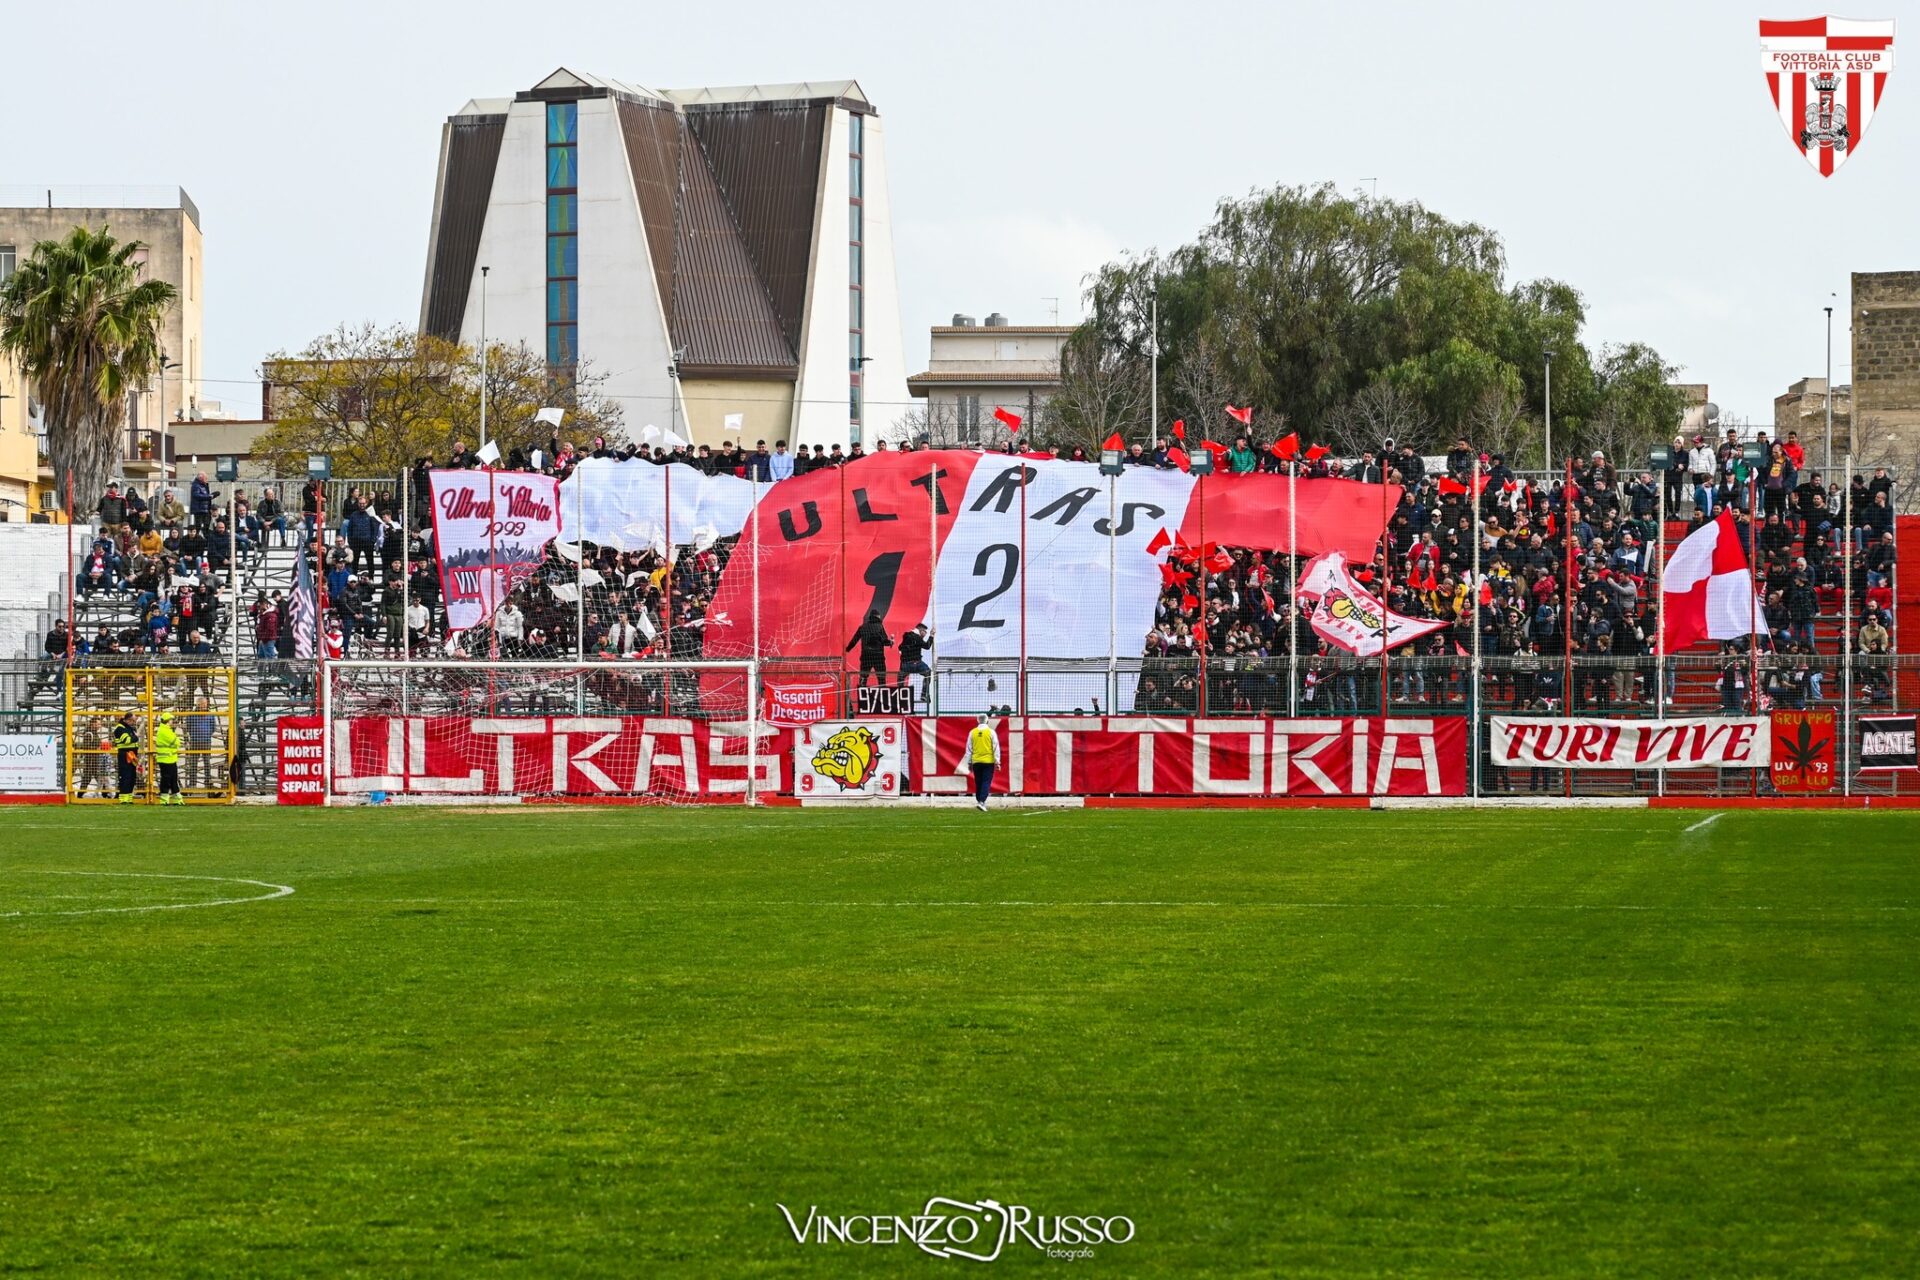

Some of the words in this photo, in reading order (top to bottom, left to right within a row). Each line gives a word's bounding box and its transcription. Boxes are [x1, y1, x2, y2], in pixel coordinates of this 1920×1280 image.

[500, 485, 552, 521] Vittoria
[777, 465, 1165, 542] ULTRAS
[480, 521, 526, 537] 1993
[774, 690, 822, 705] Assenti
[858, 687, 911, 714] 97019
[771, 703, 825, 721] Presenti
[282, 728, 324, 741] FINCHE'
[1505, 723, 1622, 761] TURI
[1635, 724, 1757, 762] VIVE
[1861, 730, 1916, 755] ACATE
[284, 745, 323, 758] MORTE
[335, 718, 781, 793] ULTRAS
[284, 763, 309, 776] NON
[311, 763, 323, 776] CI
[1774, 762, 1794, 771] UV
[281, 780, 324, 793] SEPARI.
